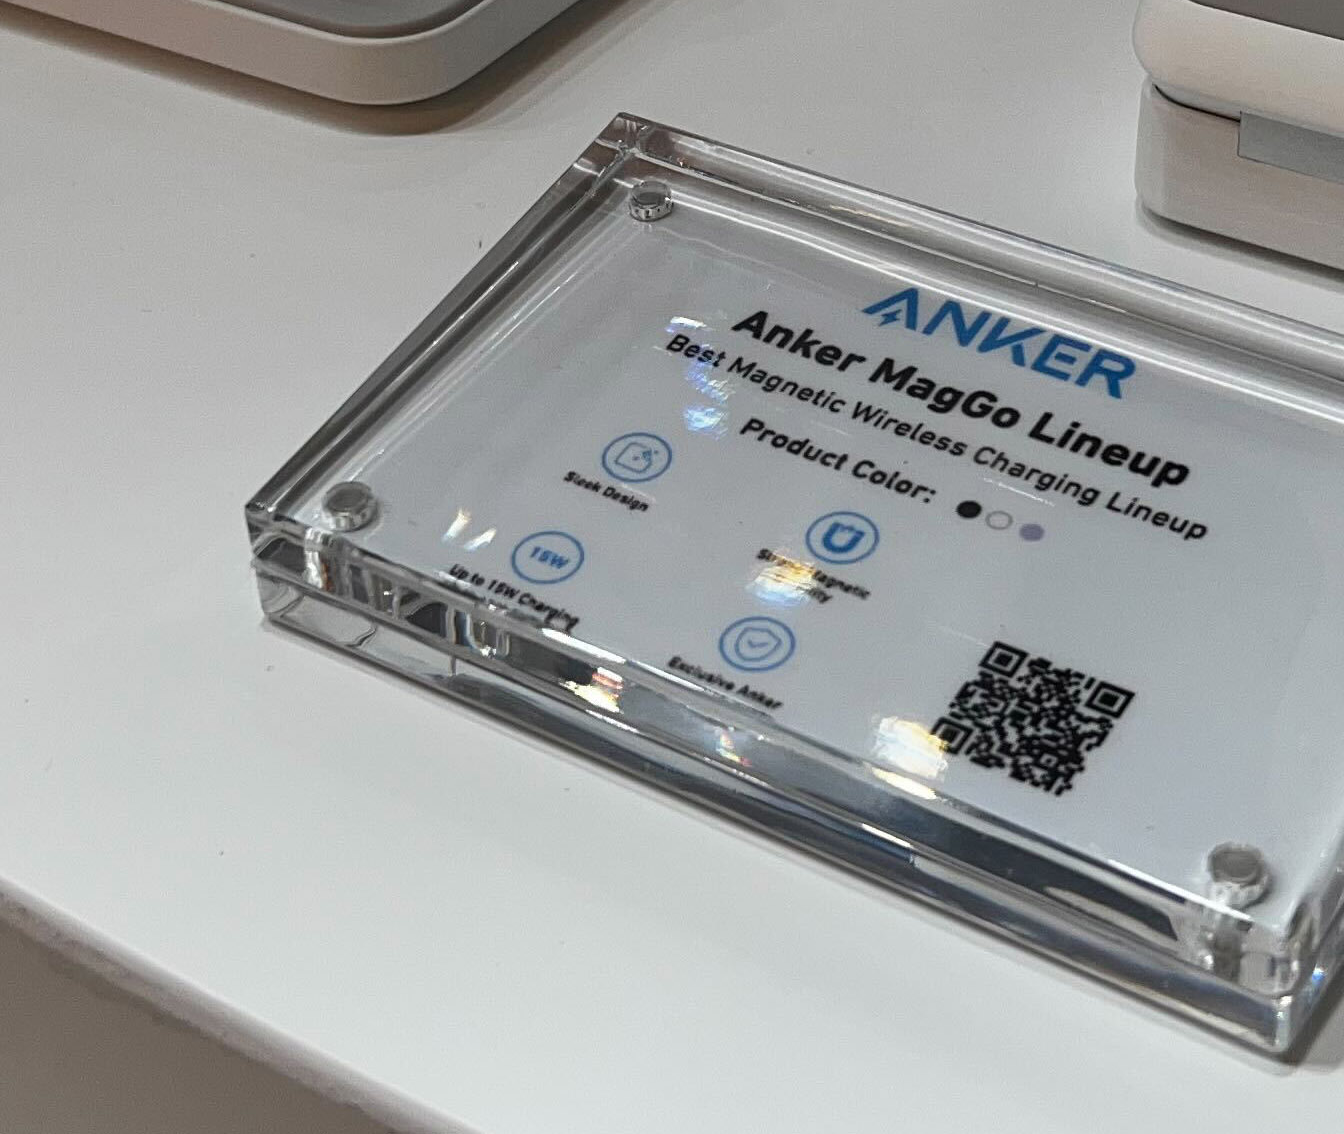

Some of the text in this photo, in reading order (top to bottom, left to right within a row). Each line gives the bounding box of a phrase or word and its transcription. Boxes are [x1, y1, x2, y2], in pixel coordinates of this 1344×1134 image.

[861, 287, 1136, 400] ANKER
[665, 333, 1208, 541] Best Magnetic Wireless Charging Lineup
[730, 310, 1190, 488] Anker MagGo Lineup
[563, 470, 649, 513] Sleek Design
[738, 416, 936, 504] Product Color:
[448, 562, 469, 582] Up
[470, 571, 486, 586] to
[487, 578, 520, 599] 15W
[529, 545, 570, 570] 15W
